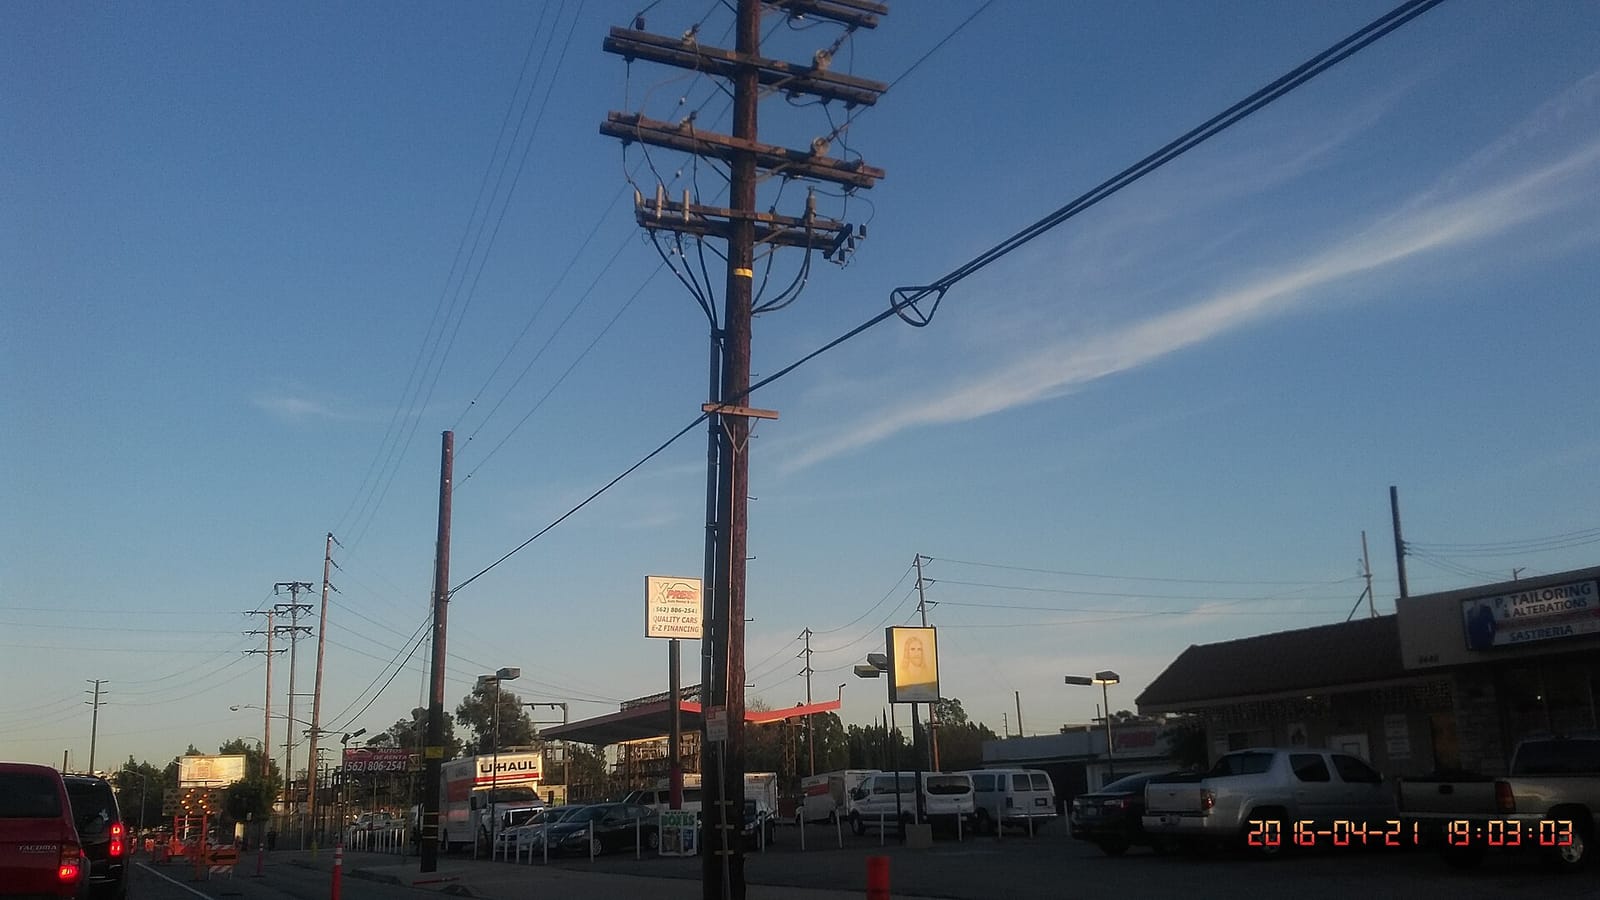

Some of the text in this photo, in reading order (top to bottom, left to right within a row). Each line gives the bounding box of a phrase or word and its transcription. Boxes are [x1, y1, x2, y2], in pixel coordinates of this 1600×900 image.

[1511, 583, 1591, 606] TAILORING
[1513, 598, 1587, 617] ALTERATIONS
[1510, 625, 1573, 641] SASTRERIA
[344, 761, 406, 773] (562) 806-2541
